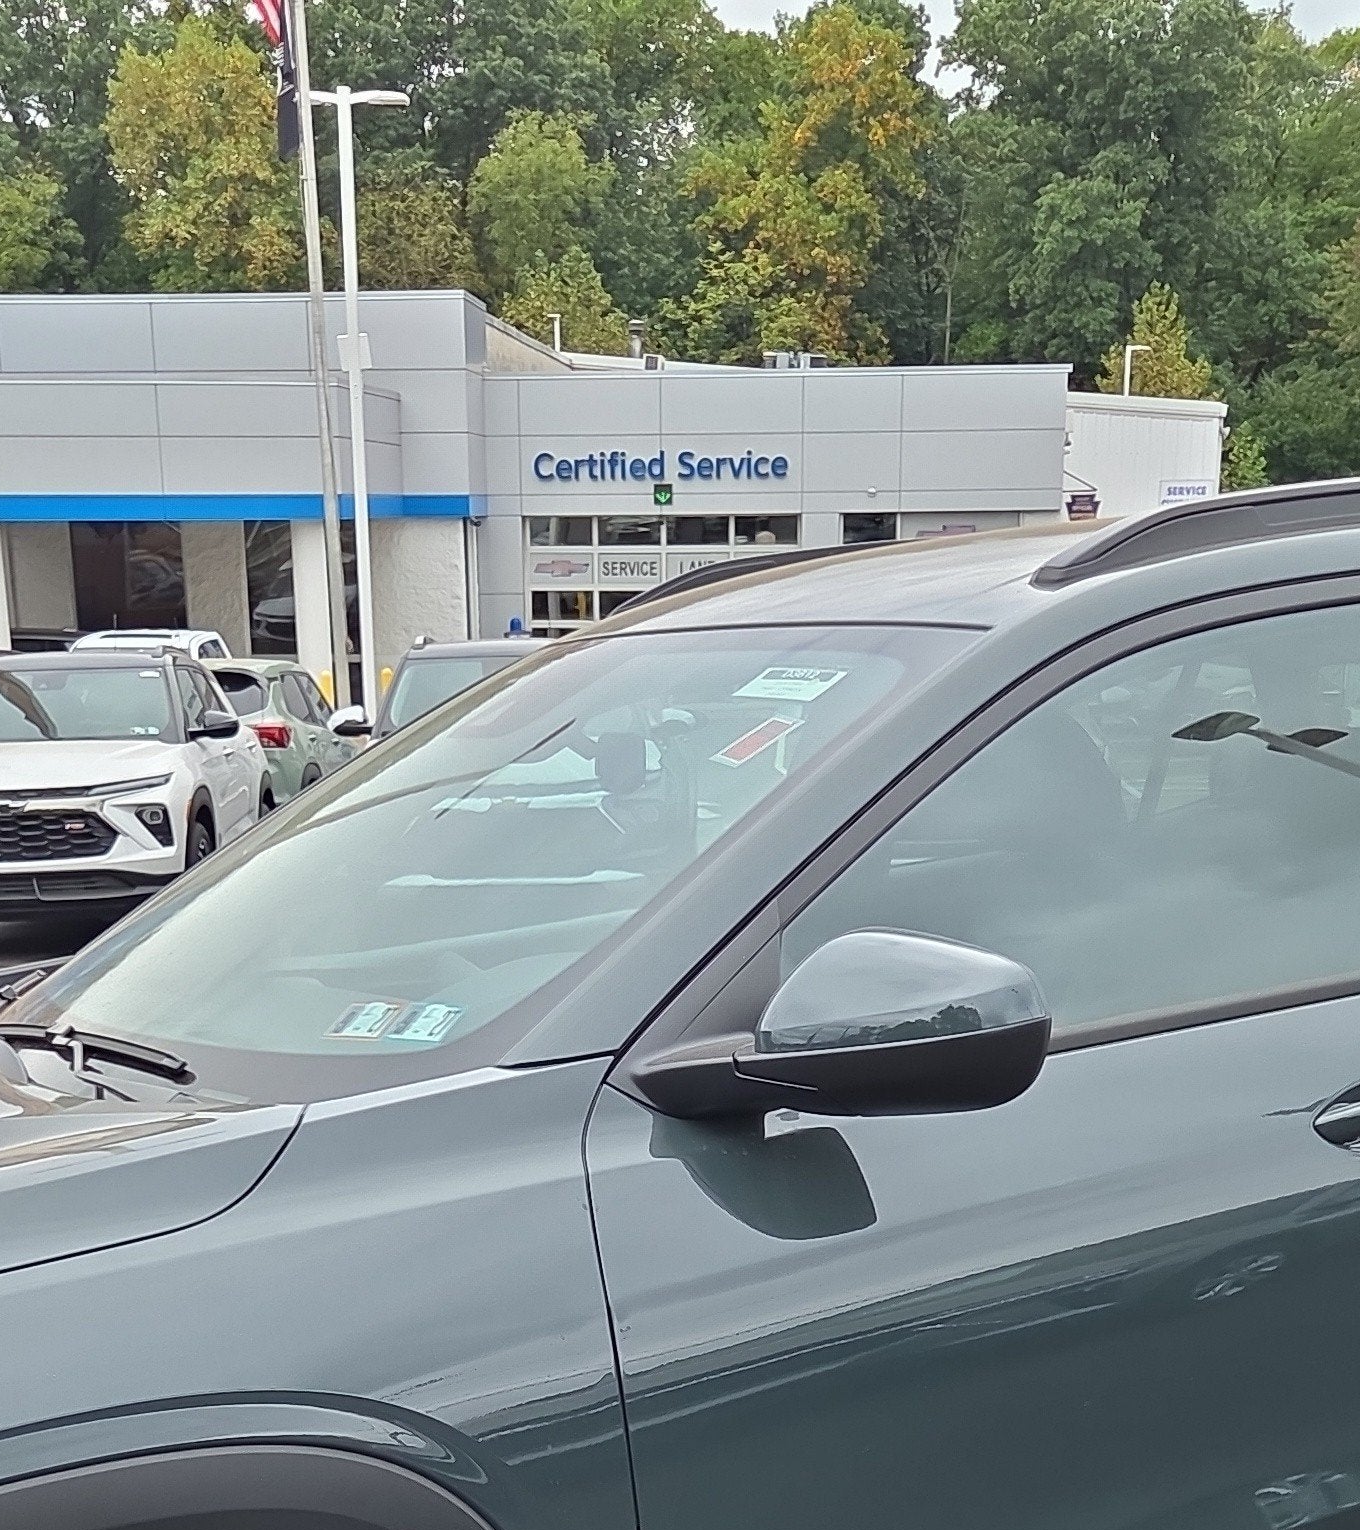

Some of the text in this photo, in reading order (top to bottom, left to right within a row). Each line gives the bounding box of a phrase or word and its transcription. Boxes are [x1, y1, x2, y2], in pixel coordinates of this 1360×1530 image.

[533, 449, 789, 482] Certified Service
[1166, 485, 1208, 496] SERVICE
[601, 561, 658, 577] SERVICE
